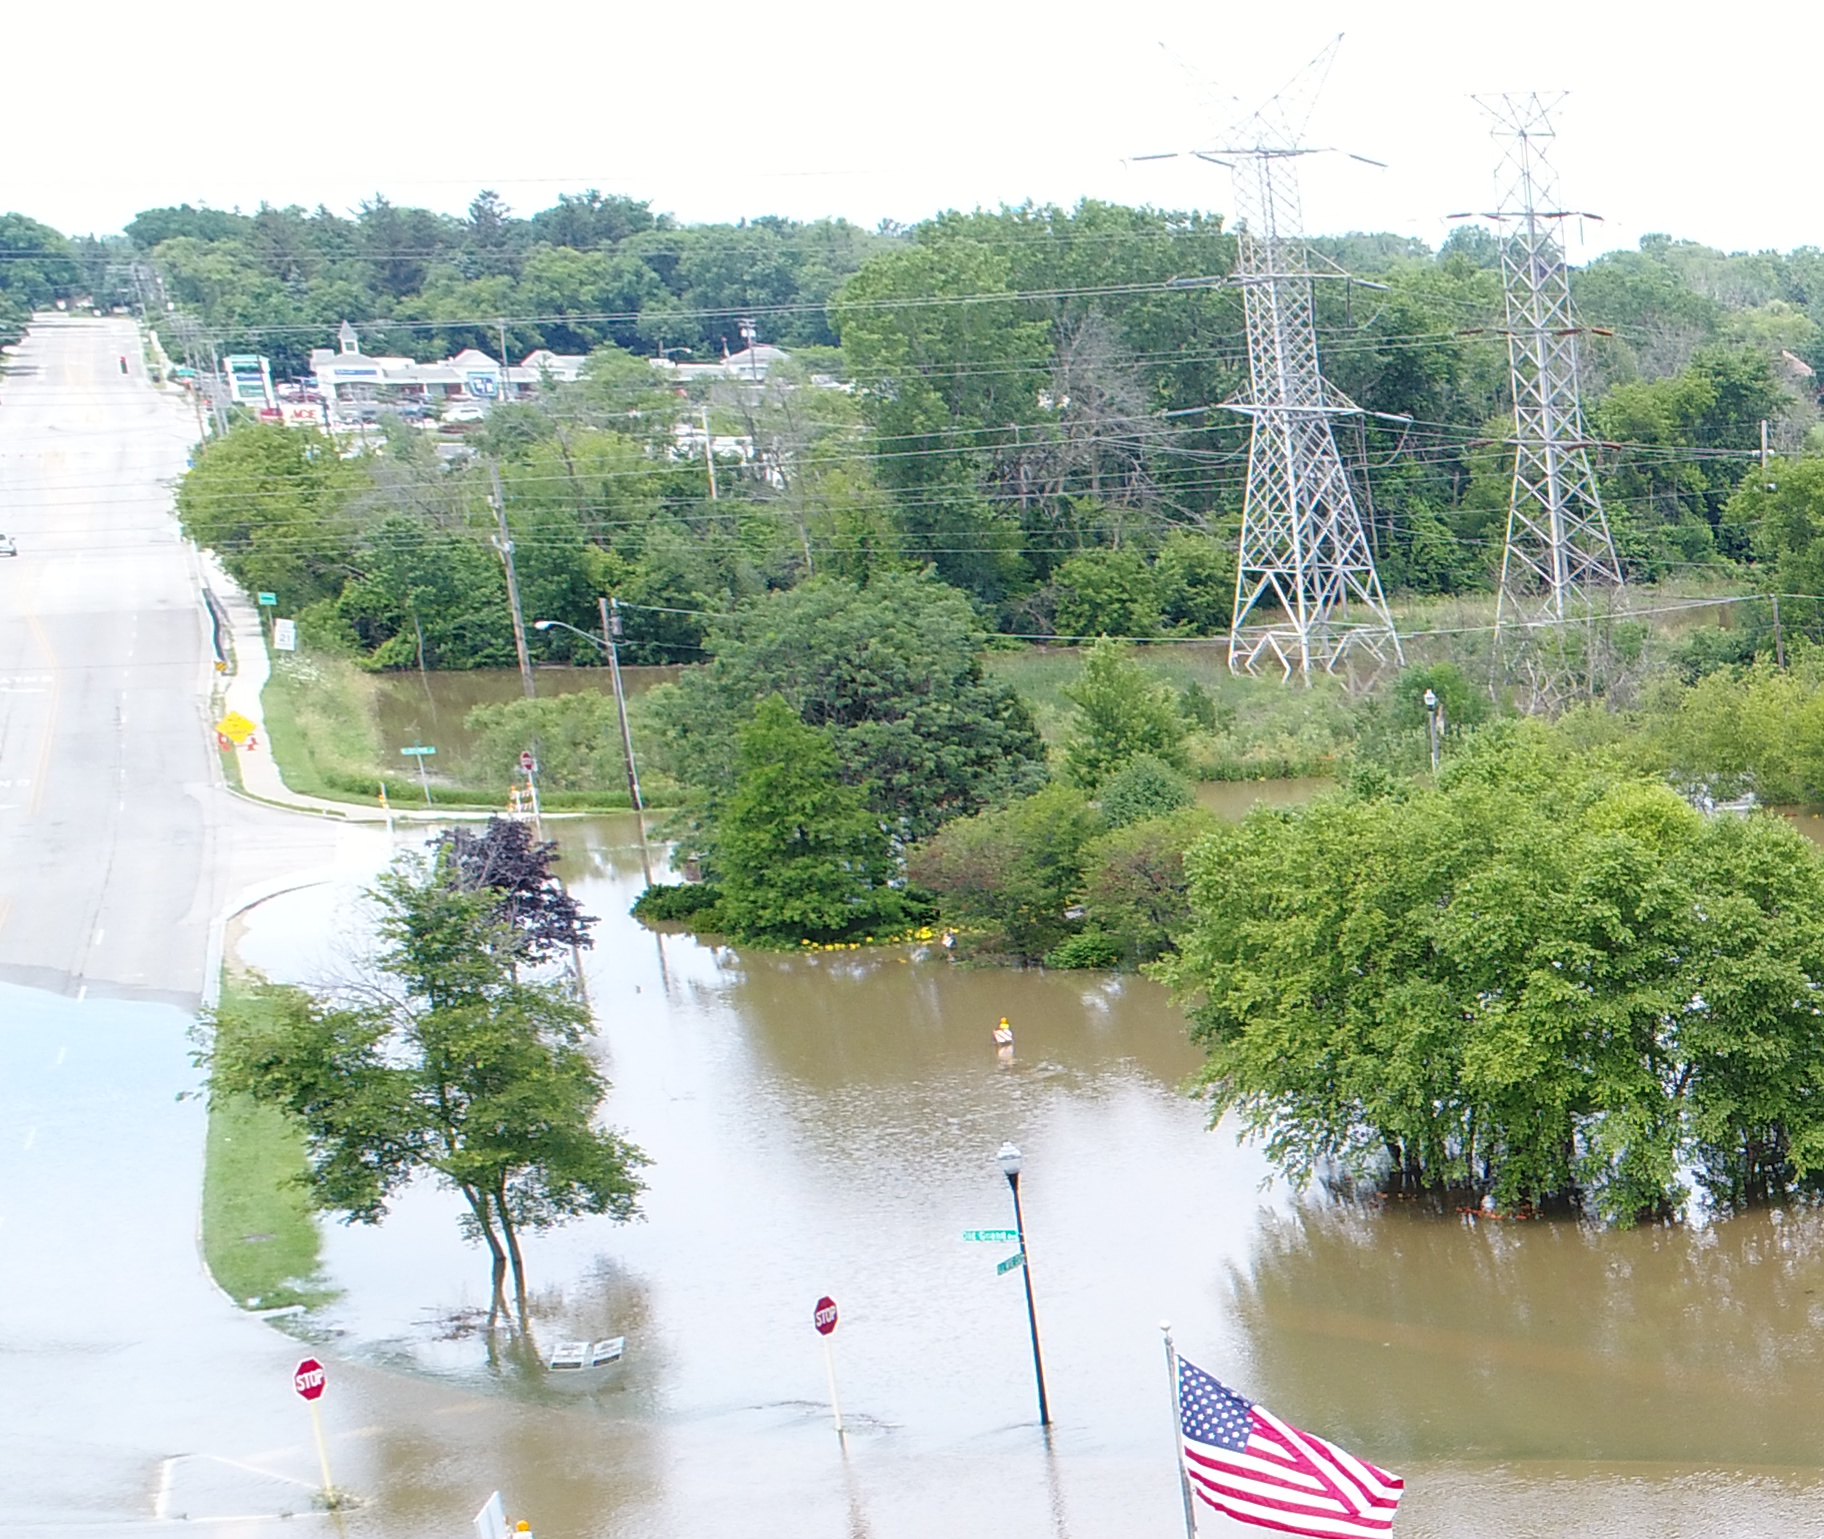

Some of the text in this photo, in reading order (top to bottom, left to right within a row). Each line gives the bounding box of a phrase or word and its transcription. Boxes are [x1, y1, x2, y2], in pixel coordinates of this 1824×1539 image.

[292, 408, 316, 419] ACE
[980, 1230, 1007, 1241] Grand
[815, 1305, 837, 1327] STOP
[296, 1369, 323, 1391] STOP
